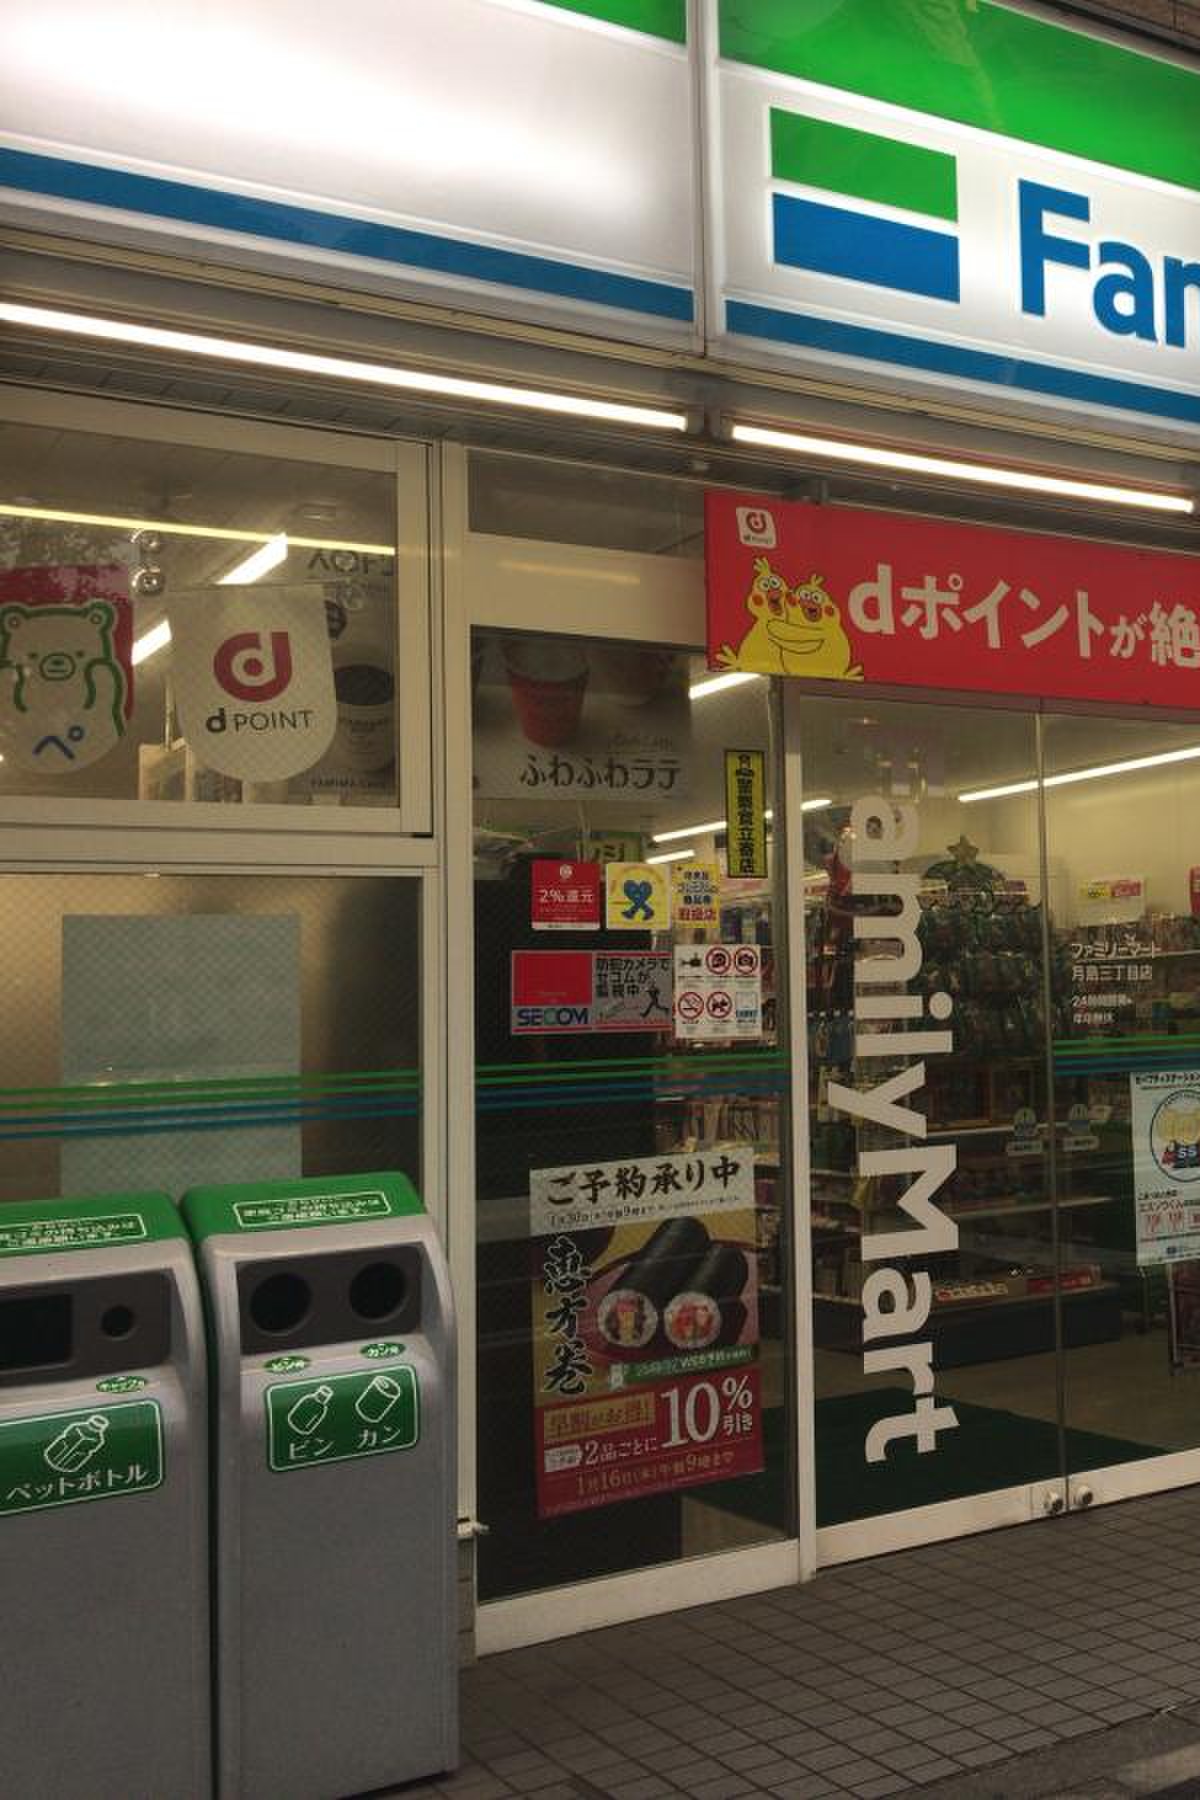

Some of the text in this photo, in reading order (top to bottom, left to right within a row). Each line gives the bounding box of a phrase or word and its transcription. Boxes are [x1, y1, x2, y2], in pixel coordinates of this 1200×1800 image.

[233, 710, 313, 731] POINT
[519, 754, 681, 791] ふわふわラテ
[1071, 943, 1163, 959] ファミリーマート
[516, 1007, 589, 1025] SECOM
[546, 1155, 740, 1205] ご予約承り中
[543, 1236, 592, 1395] 恵方巻
[289, 1426, 401, 1461] ビン カン
[584, 1439, 658, 1466] 2品ごとに
[6, 1463, 149, 1503] ペットボトル
